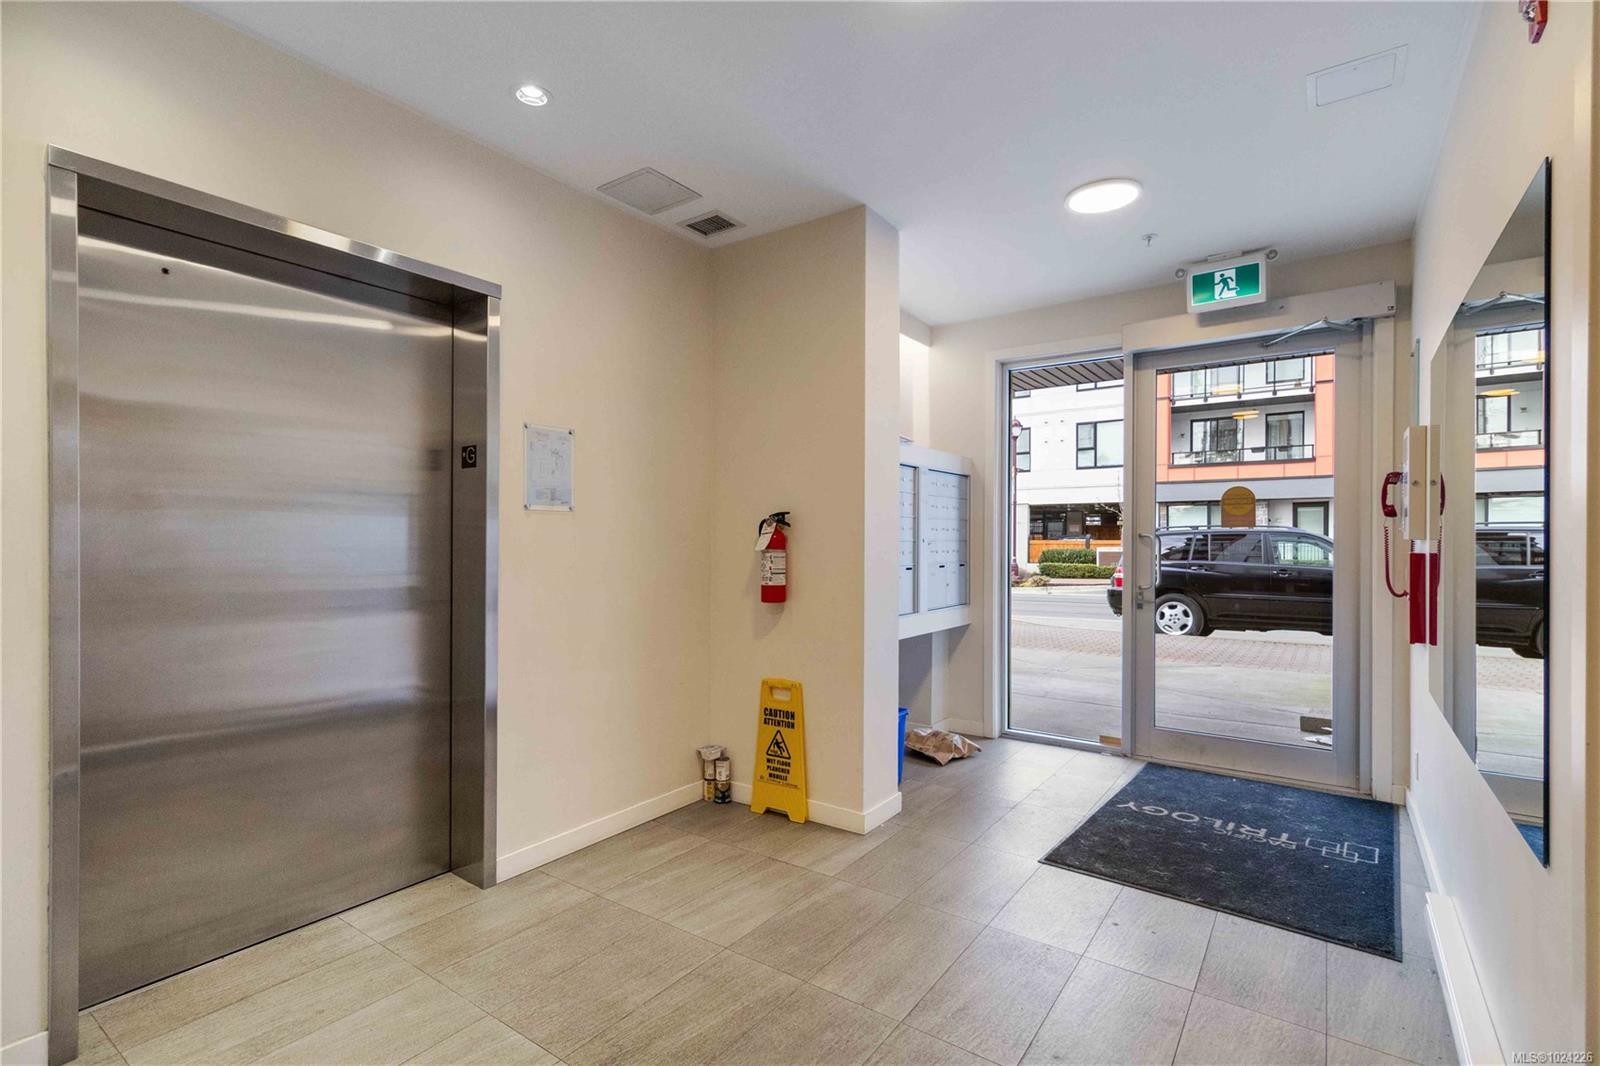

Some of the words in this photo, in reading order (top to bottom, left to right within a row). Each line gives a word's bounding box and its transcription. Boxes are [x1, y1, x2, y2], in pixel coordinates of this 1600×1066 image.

[466, 446, 475, 463] G
[763, 707, 795, 720] CAUTION
[763, 717, 795, 729] ATTENTION
[766, 765, 790, 774] PLANCHER
[777, 759, 791, 767] FLOOR
[1117, 802, 1296, 845] TRILOGY
[1213, 829, 1297, 850] PACIFIC
